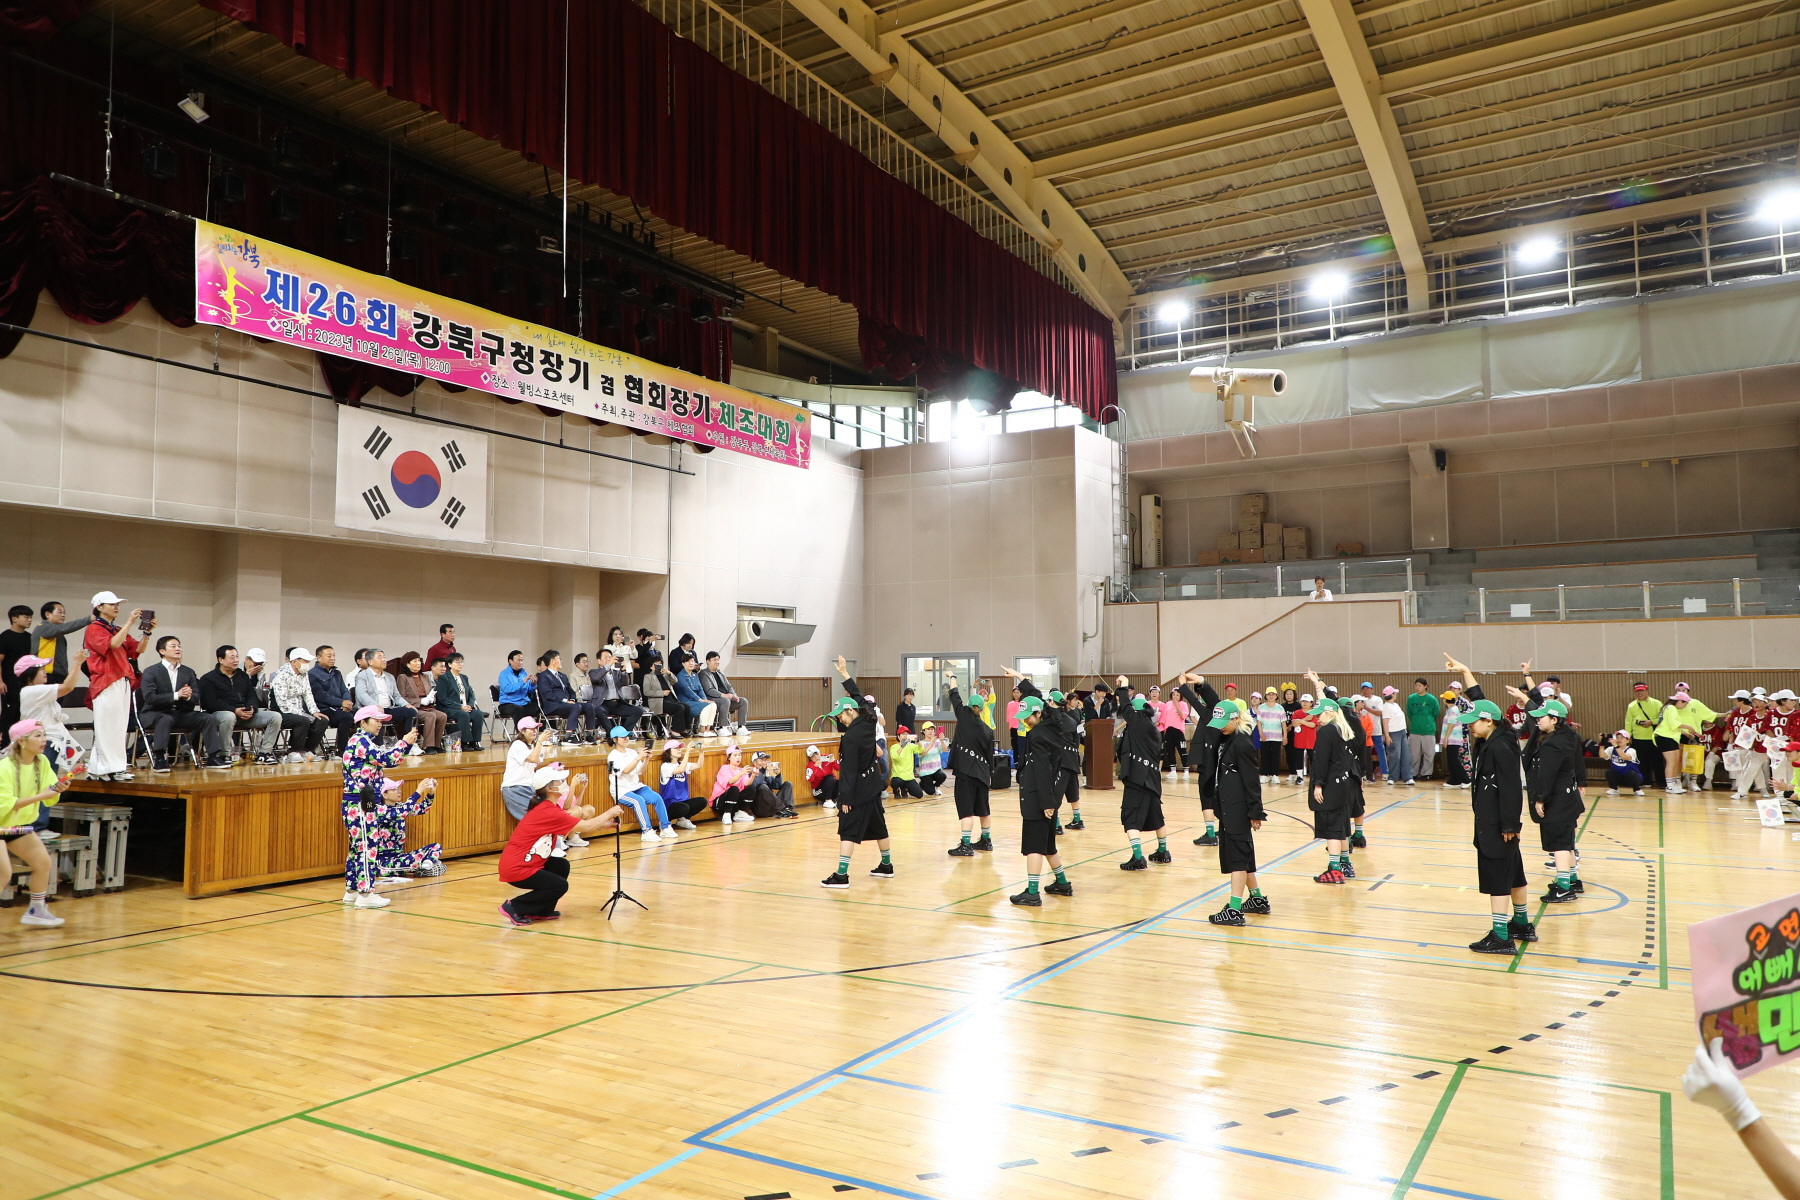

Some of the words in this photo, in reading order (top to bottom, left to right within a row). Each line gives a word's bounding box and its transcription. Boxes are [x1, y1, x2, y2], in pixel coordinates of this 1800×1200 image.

[237, 239, 260, 269] 강북
[263, 268, 398, 339] 제26회
[413, 311, 589, 391] 강북구청장기
[601, 374, 615, 397] 겸
[624, 374, 711, 424] 협회장기
[719, 401, 791, 445] 체조대회
[282, 320, 305, 340] 일시
[315, 329, 353, 352] 2023년
[356, 340, 379, 358] 10월
[425, 357, 451, 374] 12:00
[492, 374, 510, 389] 장소
[517, 380, 575, 406] 웰빙스포츠센터
